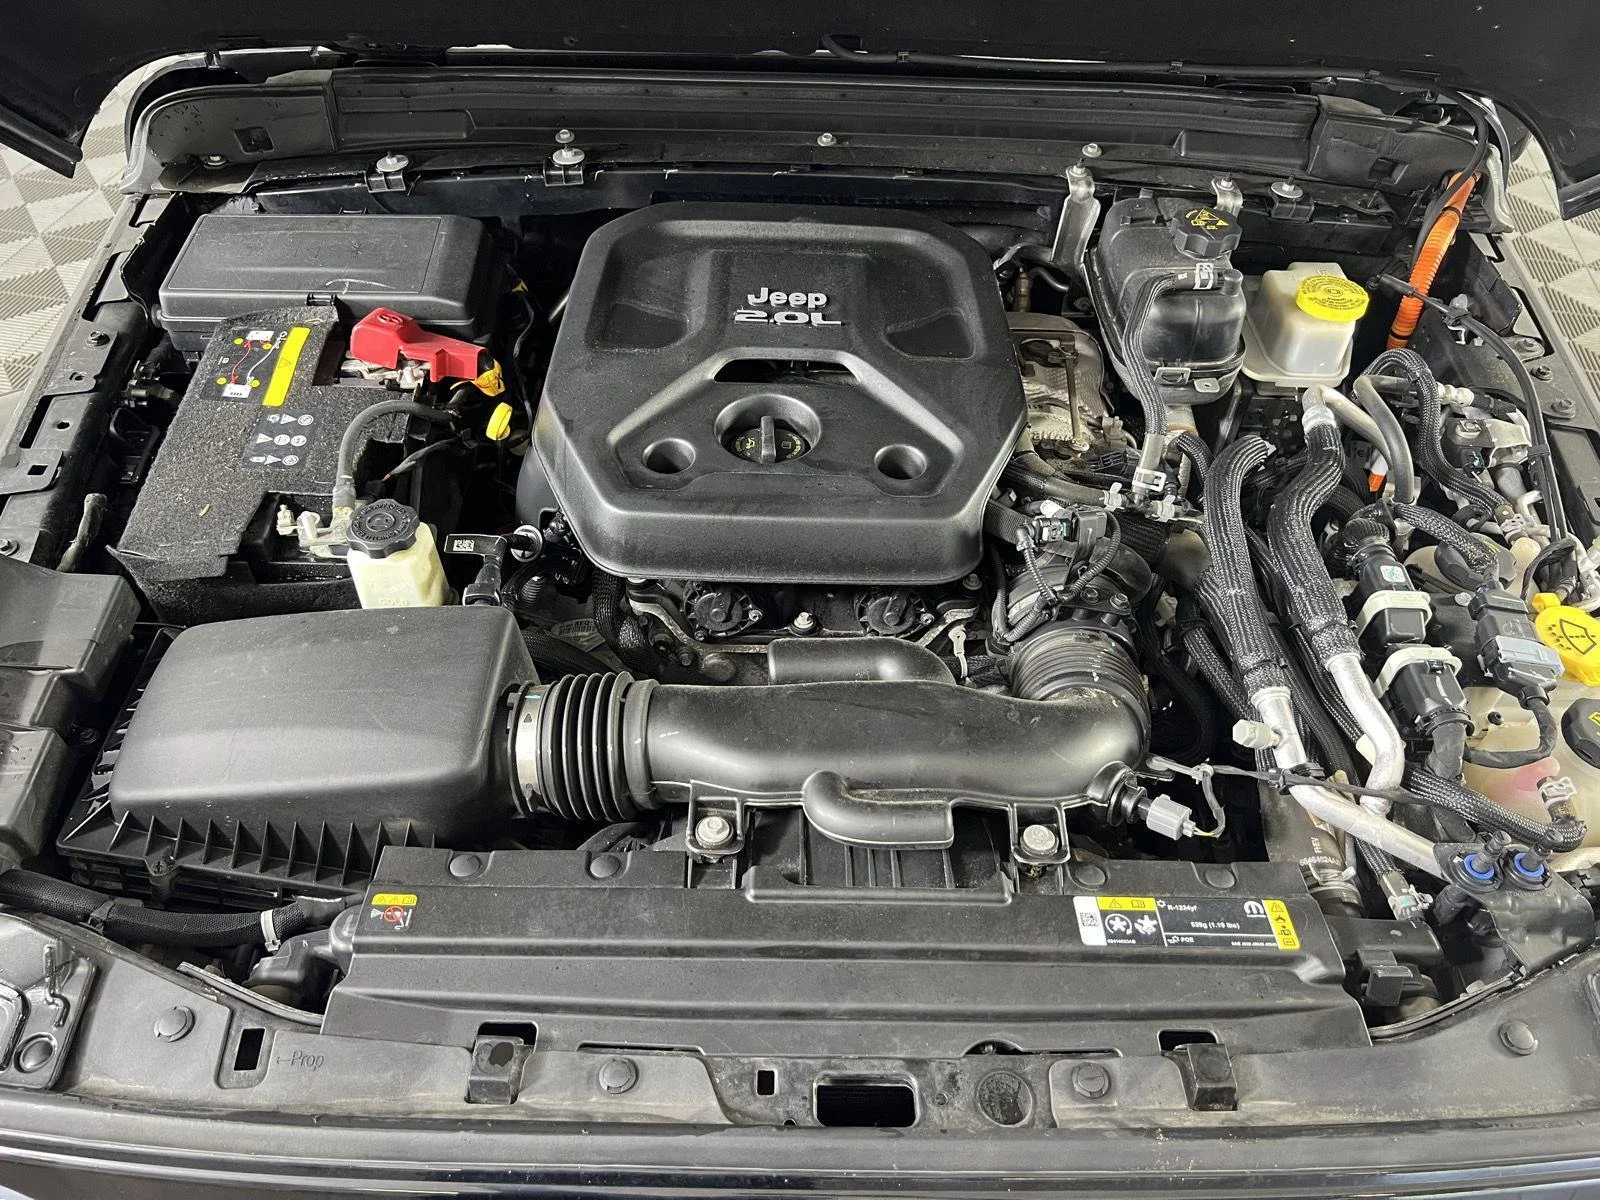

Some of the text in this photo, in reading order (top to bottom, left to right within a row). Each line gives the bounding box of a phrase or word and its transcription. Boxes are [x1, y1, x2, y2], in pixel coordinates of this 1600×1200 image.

[747, 287, 828, 309] Jeep
[735, 310, 842, 325] 2.0L
[1167, 904, 1197, 912] R-1234yf
[290, 1050, 325, 1071] Prop
